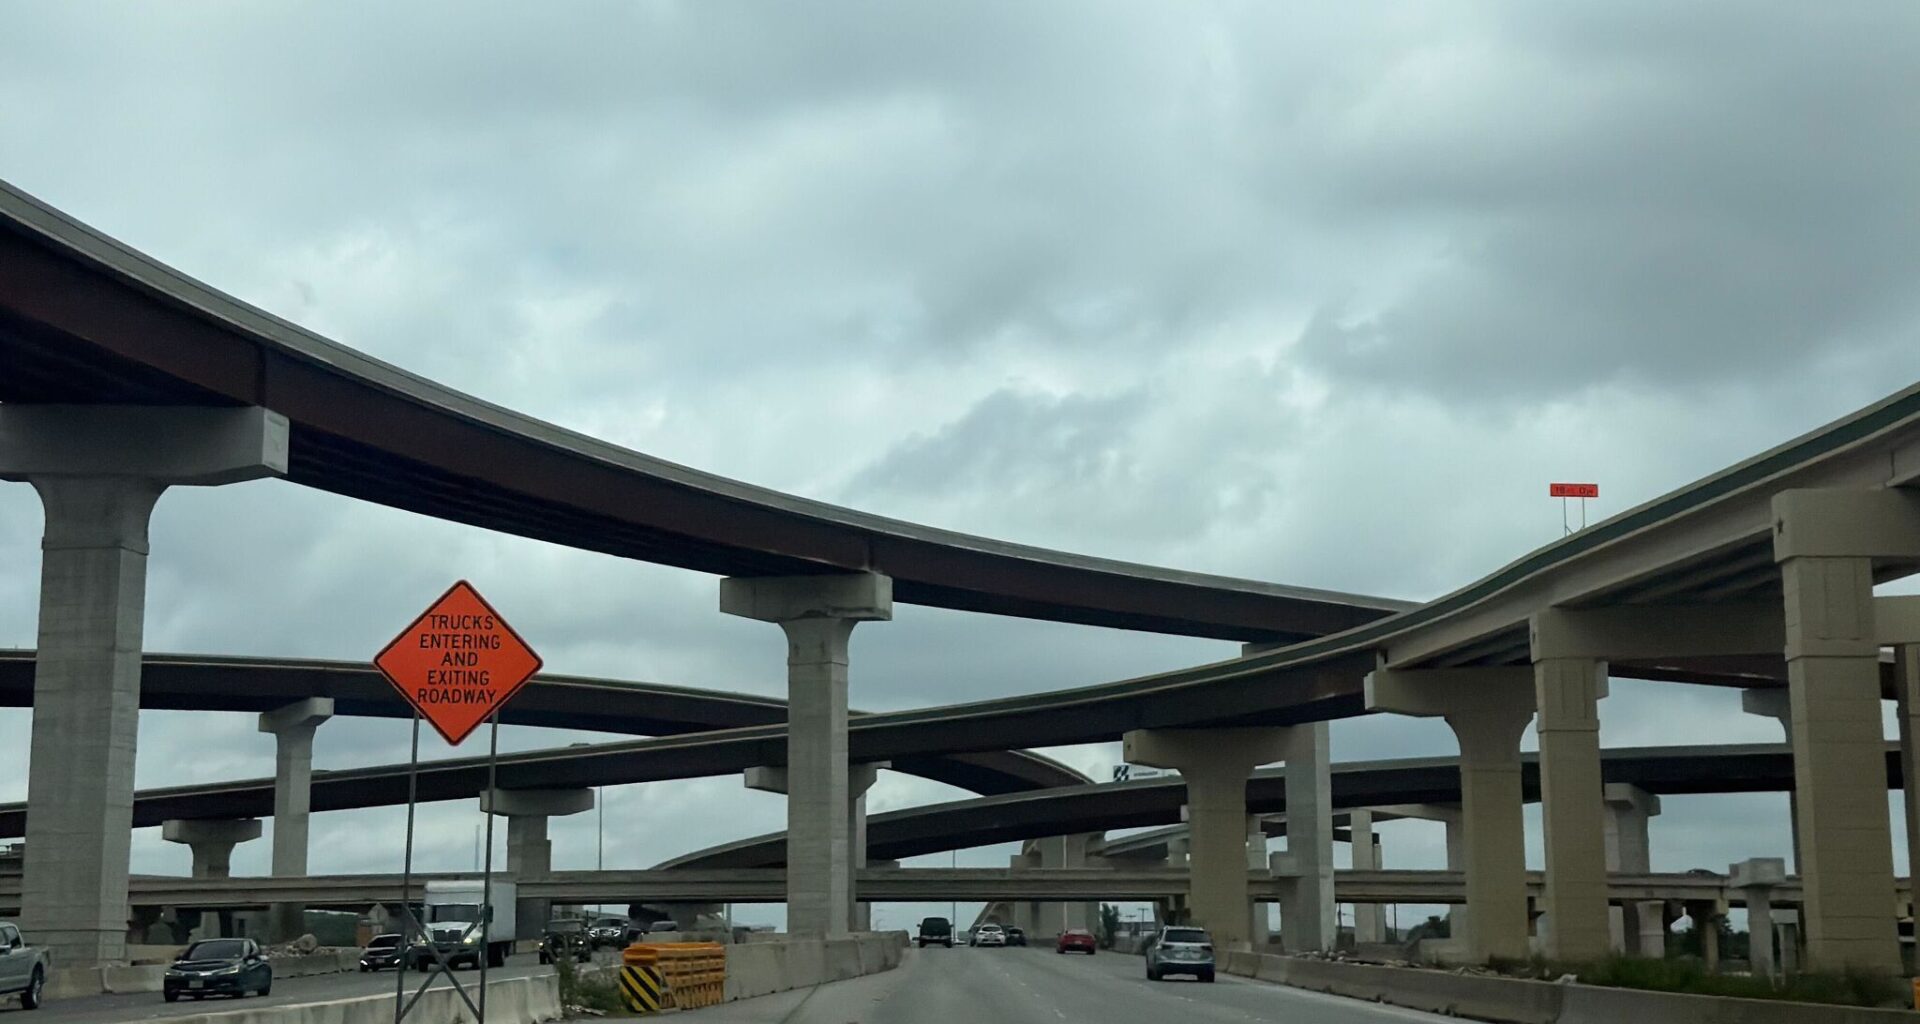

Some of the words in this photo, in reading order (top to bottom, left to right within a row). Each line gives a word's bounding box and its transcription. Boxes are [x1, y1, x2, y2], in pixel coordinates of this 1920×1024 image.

[430, 615, 494, 630] TRUCKS
[420, 634, 500, 649] ENTERING
[441, 652, 478, 666] AND
[428, 670, 490, 686] EXITING
[418, 688, 496, 704] ROADWAY
